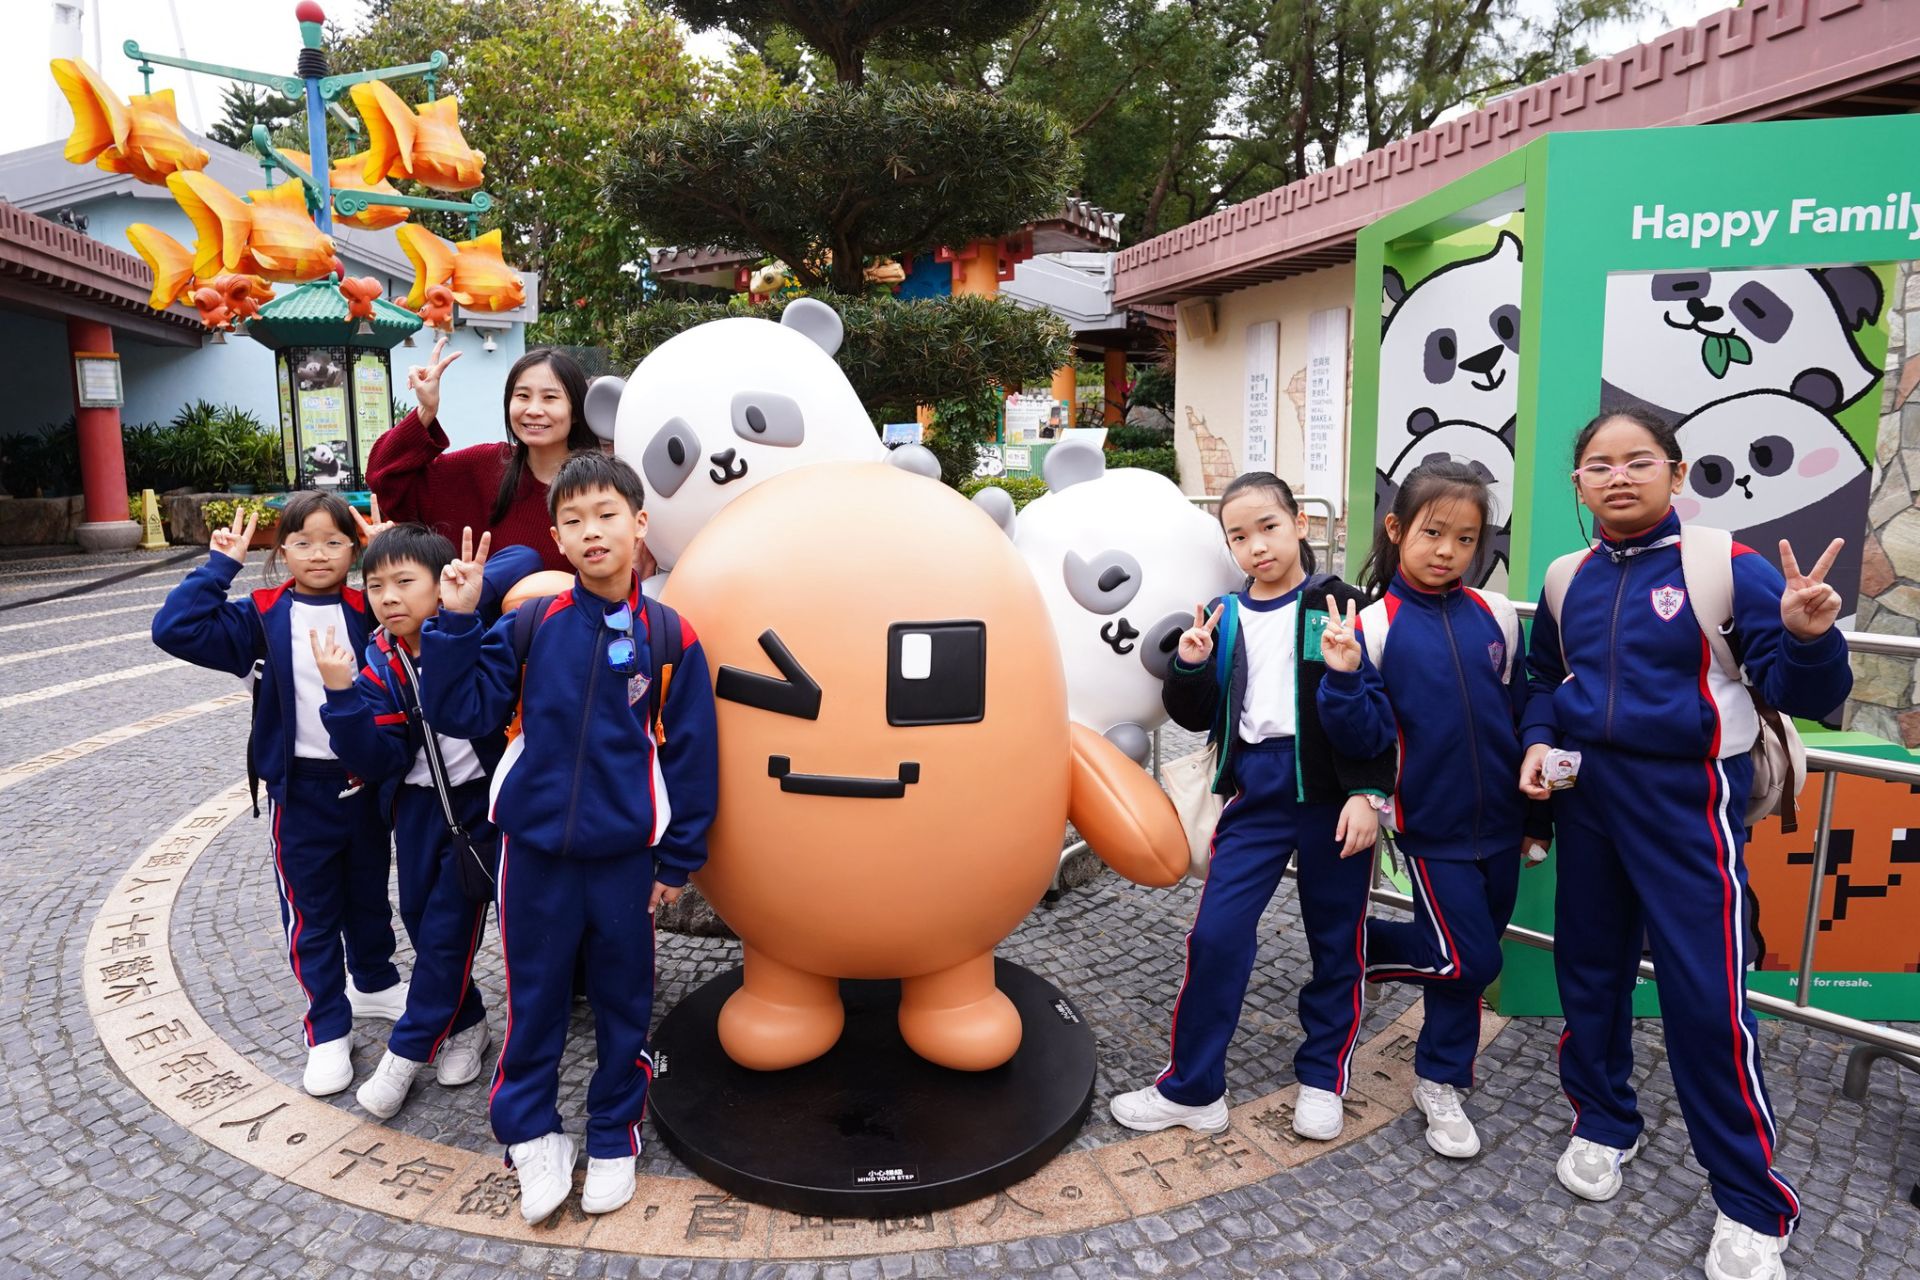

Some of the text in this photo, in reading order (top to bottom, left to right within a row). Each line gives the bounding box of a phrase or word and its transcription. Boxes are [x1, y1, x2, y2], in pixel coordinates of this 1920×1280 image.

[1632, 204, 1779, 248] Happy
[1813, 977, 1832, 987] for
[1833, 978, 1873, 987] resale.
